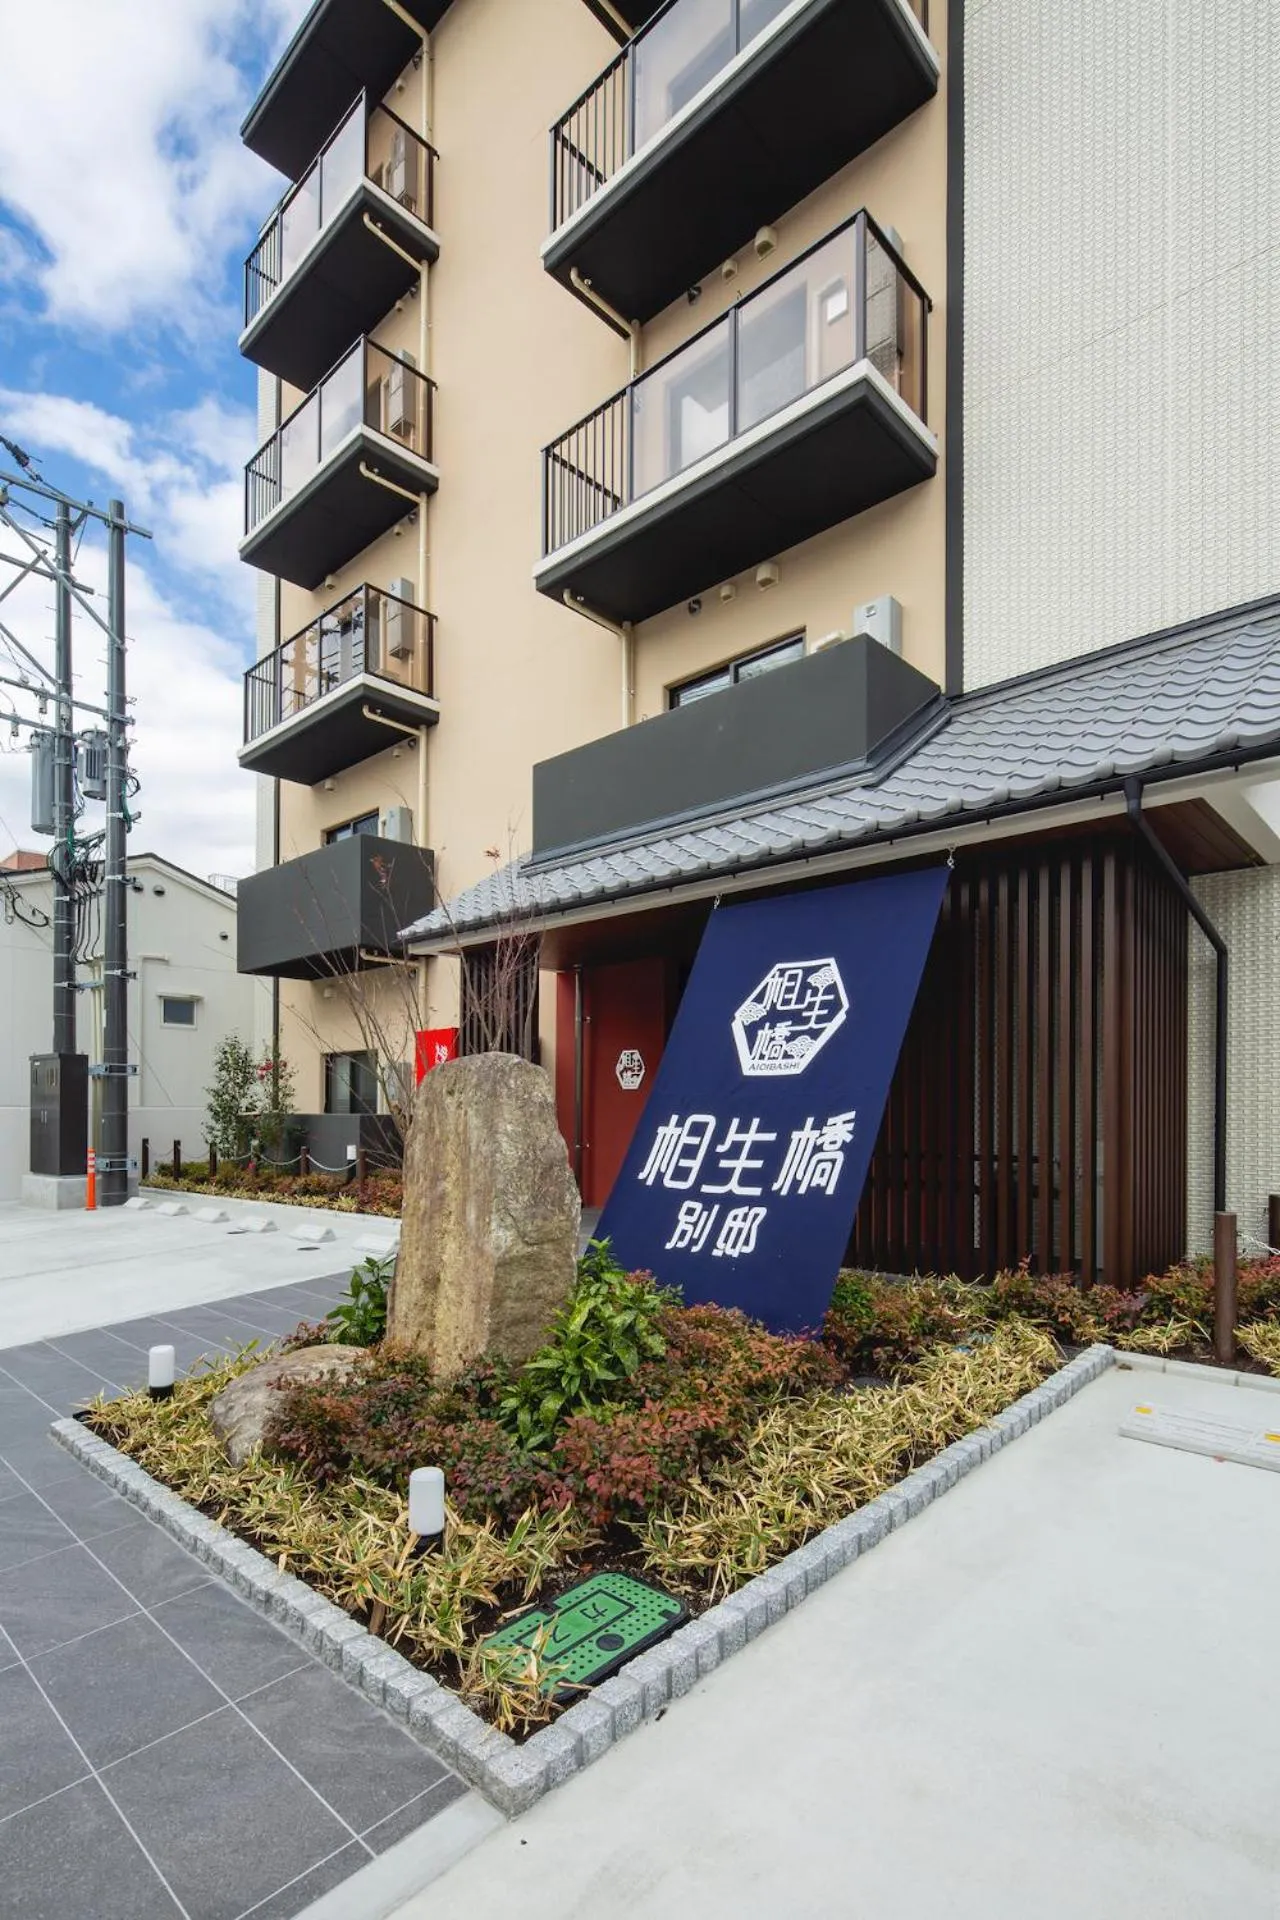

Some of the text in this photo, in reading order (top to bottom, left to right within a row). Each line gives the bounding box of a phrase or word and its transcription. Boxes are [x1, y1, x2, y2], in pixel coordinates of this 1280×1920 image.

[748, 1062, 801, 1072] AIOIBASHI
[638, 1111, 856, 1196] 相生橋
[664, 1201, 768, 1258] 別邸
